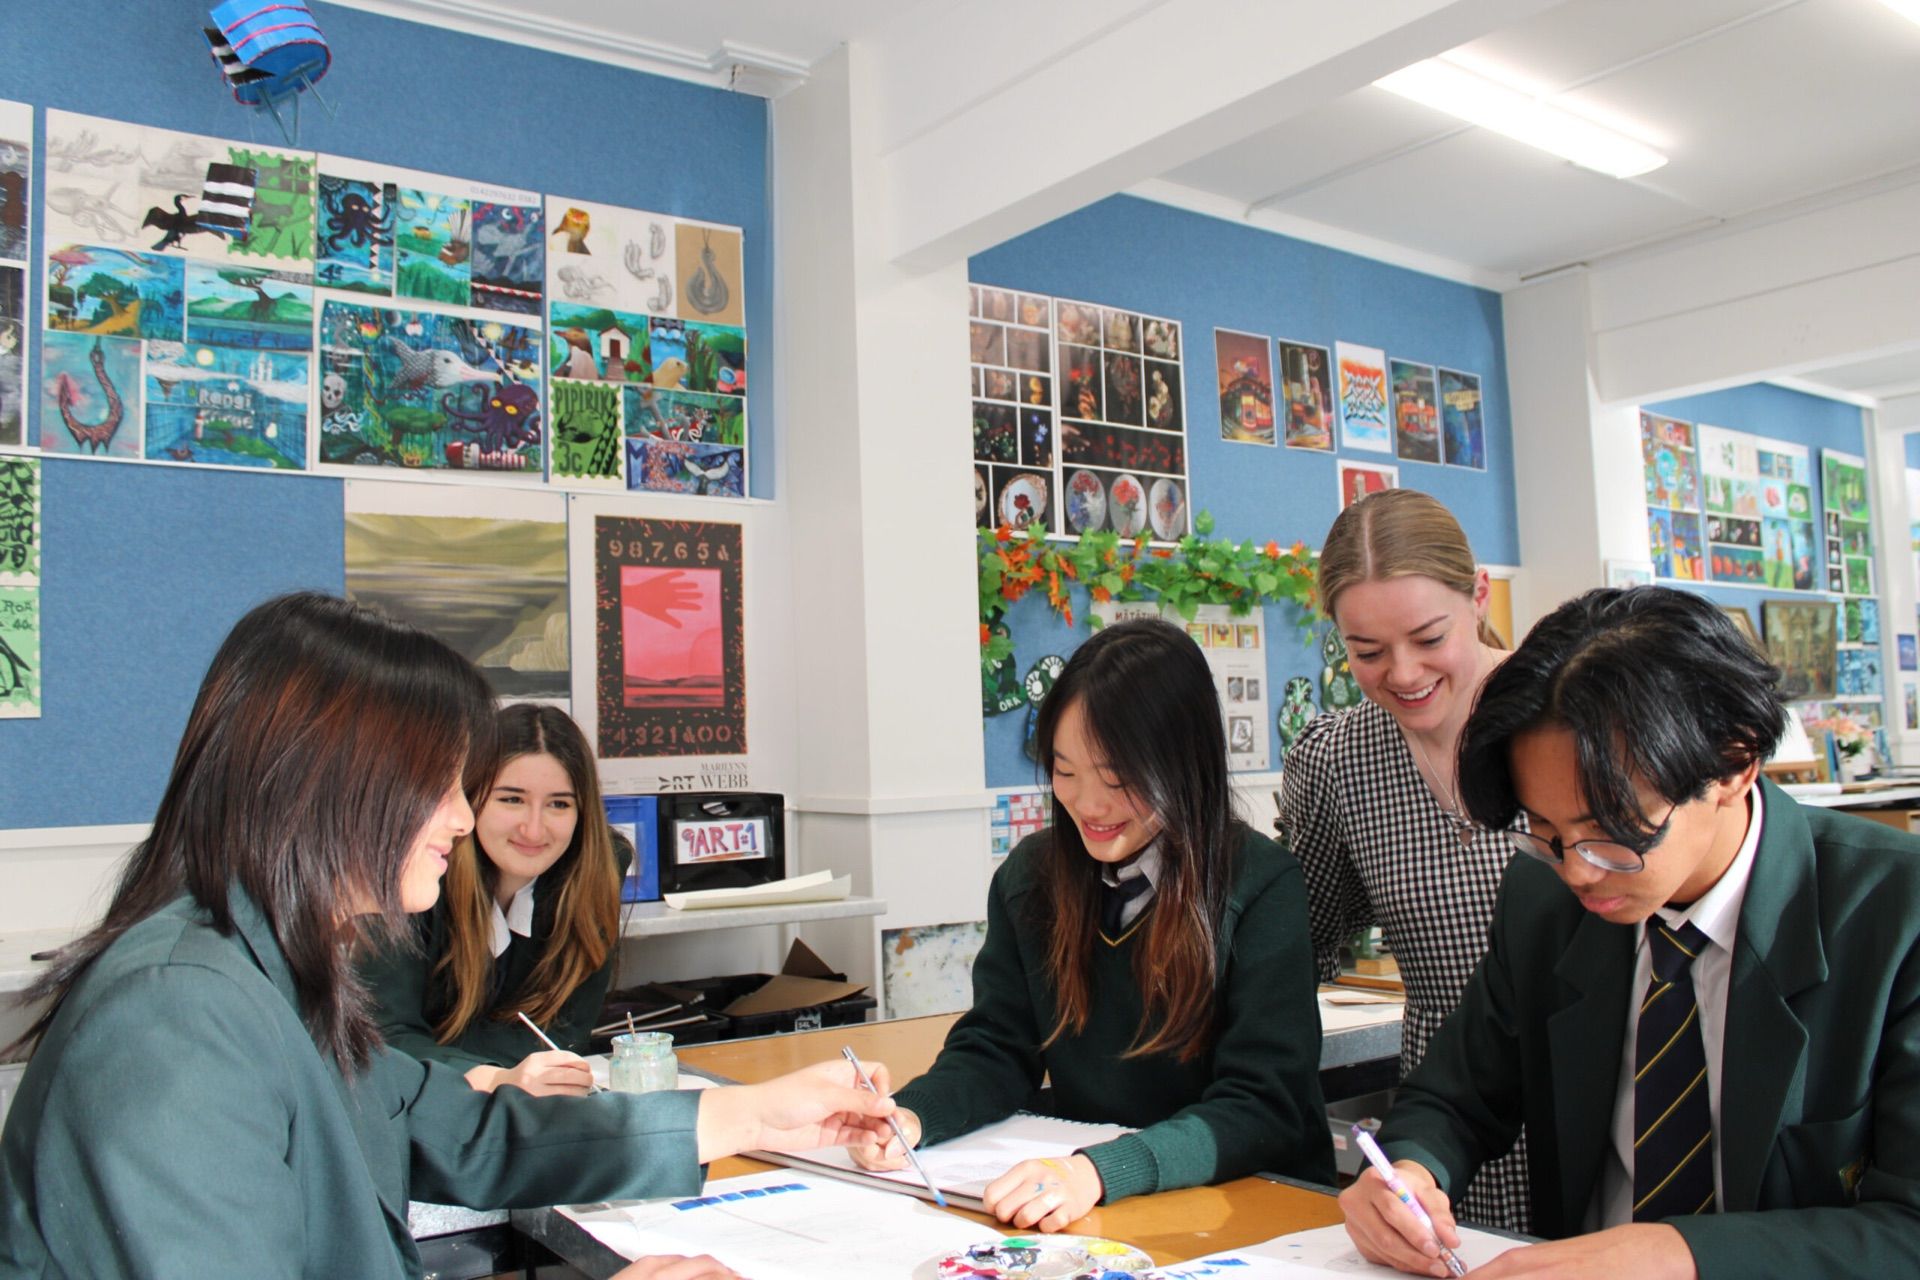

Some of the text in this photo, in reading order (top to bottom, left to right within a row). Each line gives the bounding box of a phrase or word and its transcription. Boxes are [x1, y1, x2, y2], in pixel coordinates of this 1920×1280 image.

[559, 443, 583, 472] 3c
[999, 697, 1022, 712] ORA
[701, 773, 749, 789] WEBB
